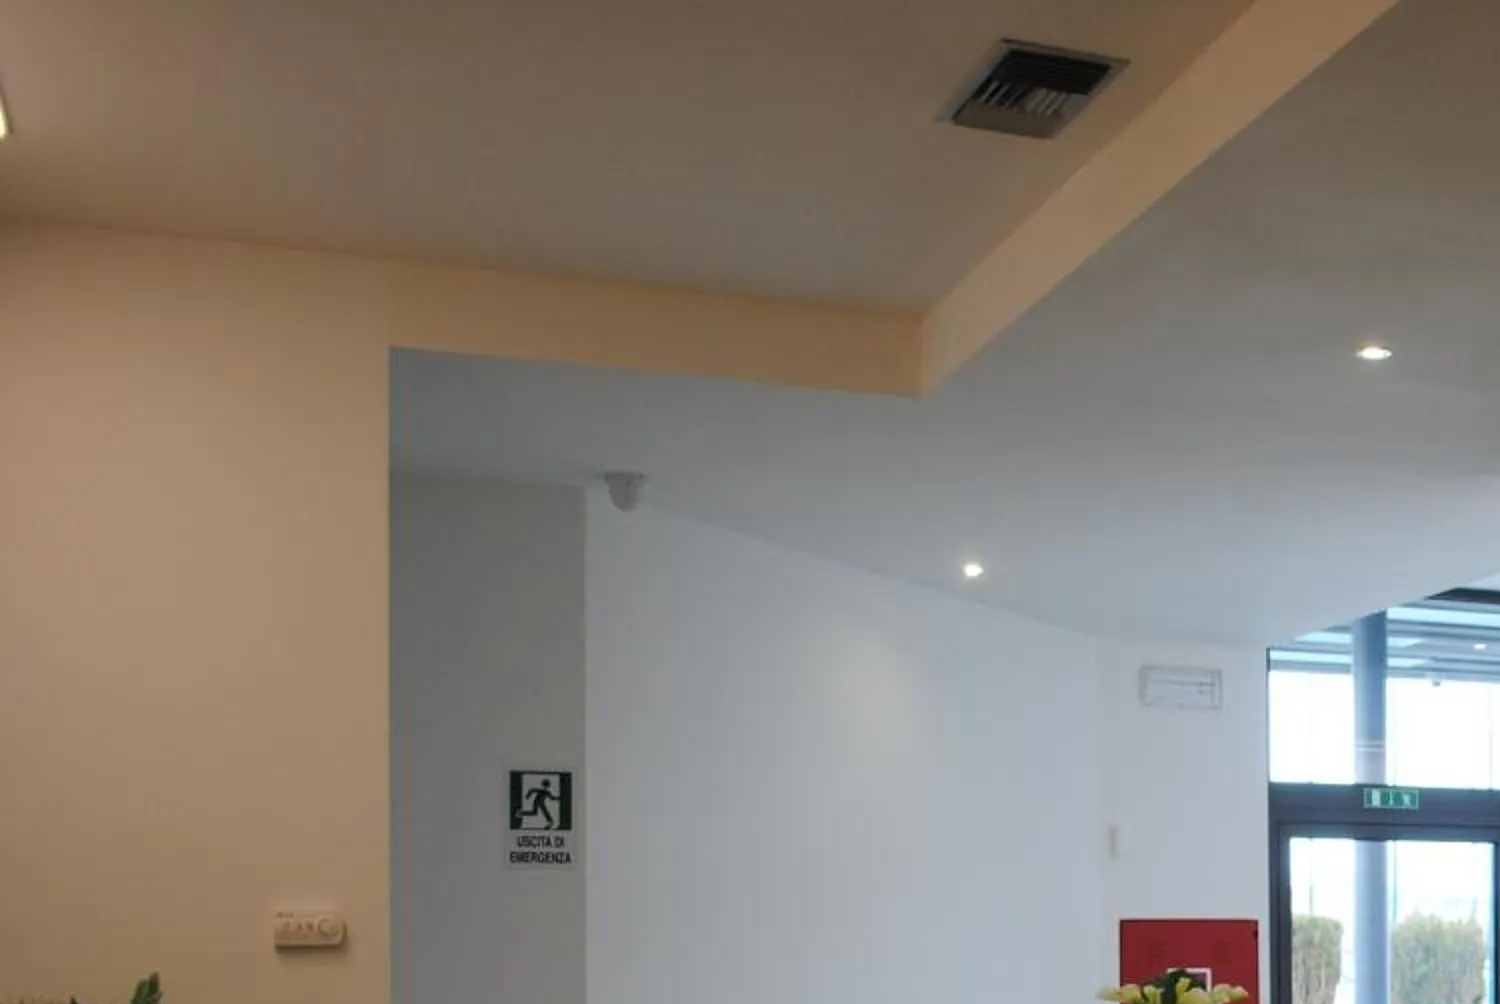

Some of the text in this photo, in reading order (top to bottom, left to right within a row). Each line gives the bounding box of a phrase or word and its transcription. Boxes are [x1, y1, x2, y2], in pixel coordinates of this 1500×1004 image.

[516, 836, 565, 848] USCITA DI
[510, 851, 572, 864] EMERGENZA
